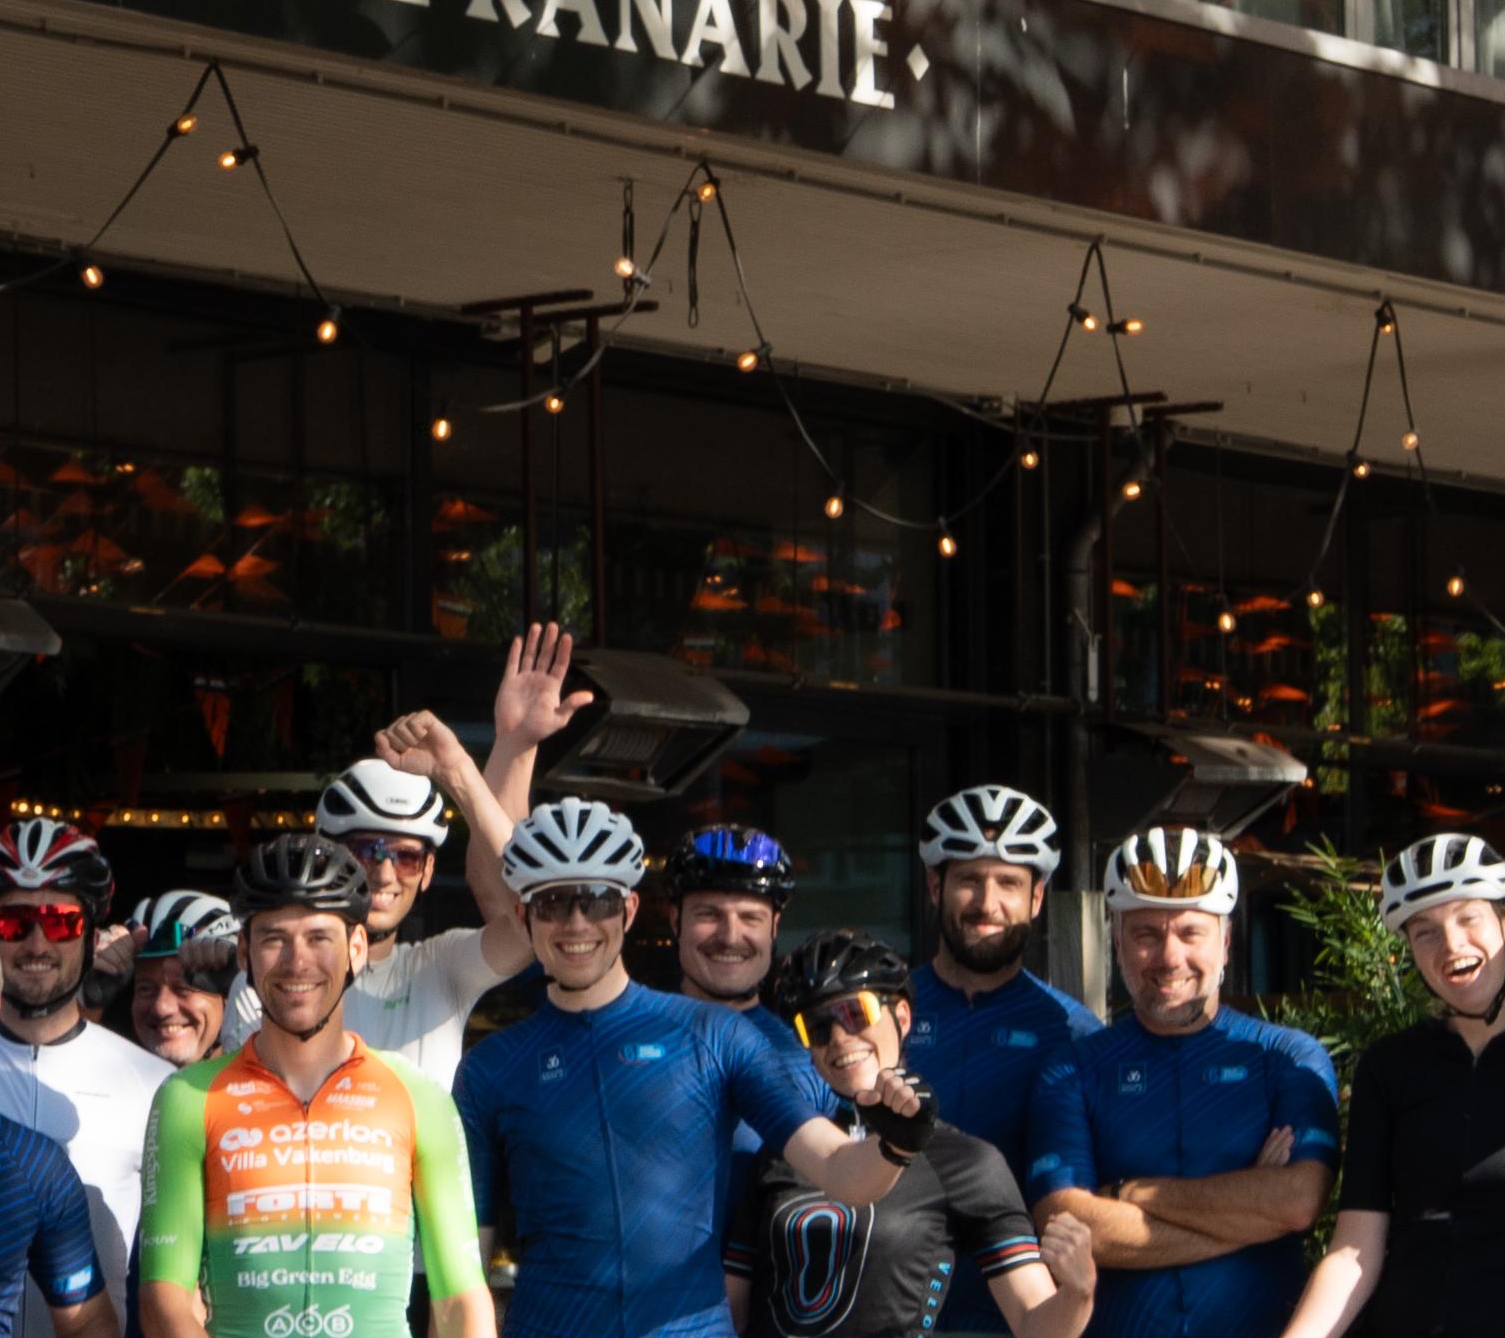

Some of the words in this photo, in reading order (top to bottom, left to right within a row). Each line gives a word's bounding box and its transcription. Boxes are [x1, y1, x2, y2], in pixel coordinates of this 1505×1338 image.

[269, 1119, 392, 1148] azerion
[221, 1152, 268, 1173] Villa
[273, 1145, 395, 1174] Vakenburg
[234, 1233, 384, 1255] TAVELO
[238, 1271, 269, 1290] Big
[271, 1267, 334, 1286] Green
[338, 1269, 377, 1291] Egg
